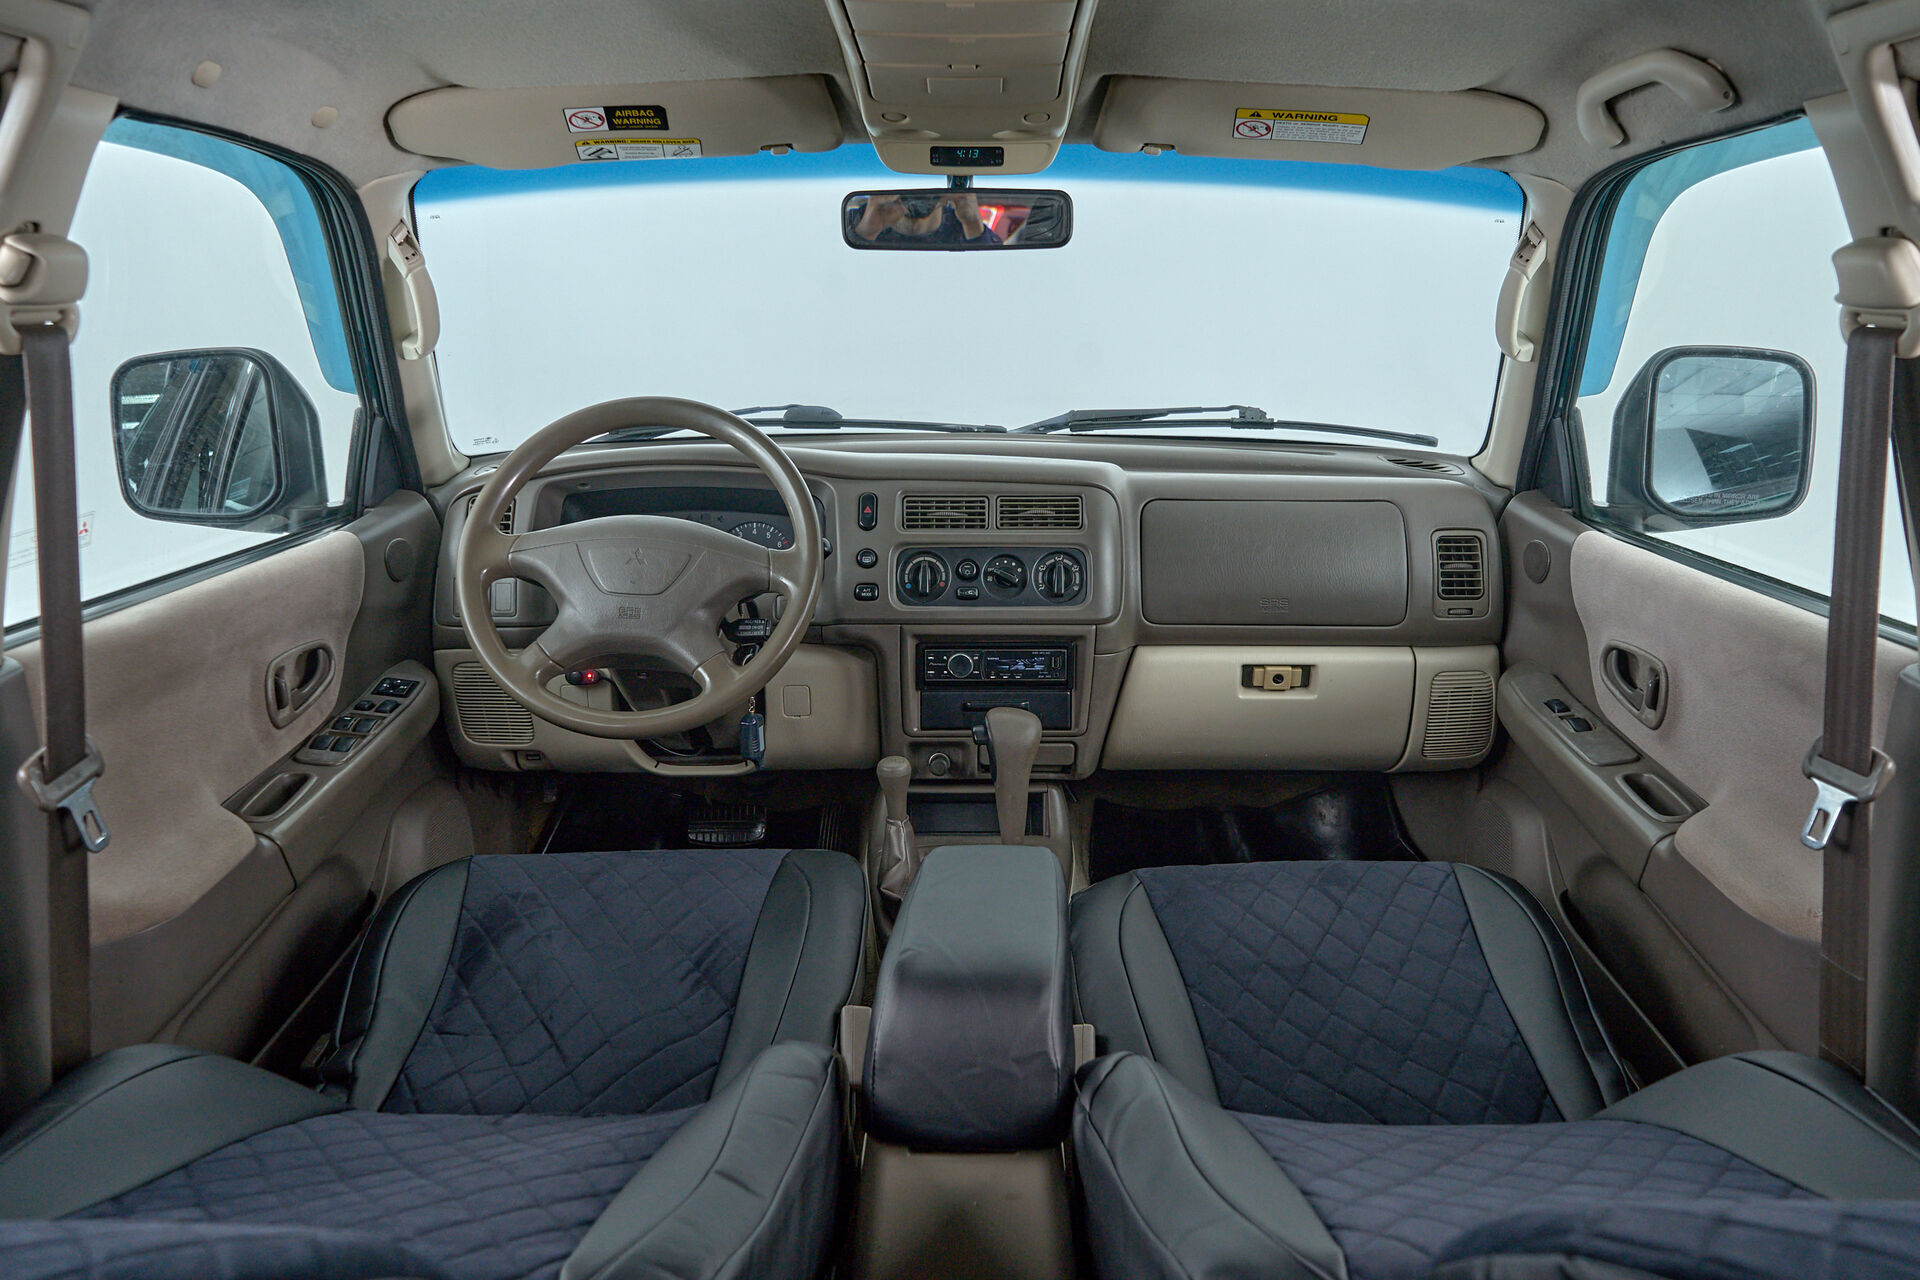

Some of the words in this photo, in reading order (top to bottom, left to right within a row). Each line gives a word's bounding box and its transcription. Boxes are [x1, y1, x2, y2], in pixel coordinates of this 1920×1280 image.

[615, 109, 655, 117] AIRBAG
[1272, 112, 1339, 121] WARNING
[956, 149, 979, 159] 4:13
